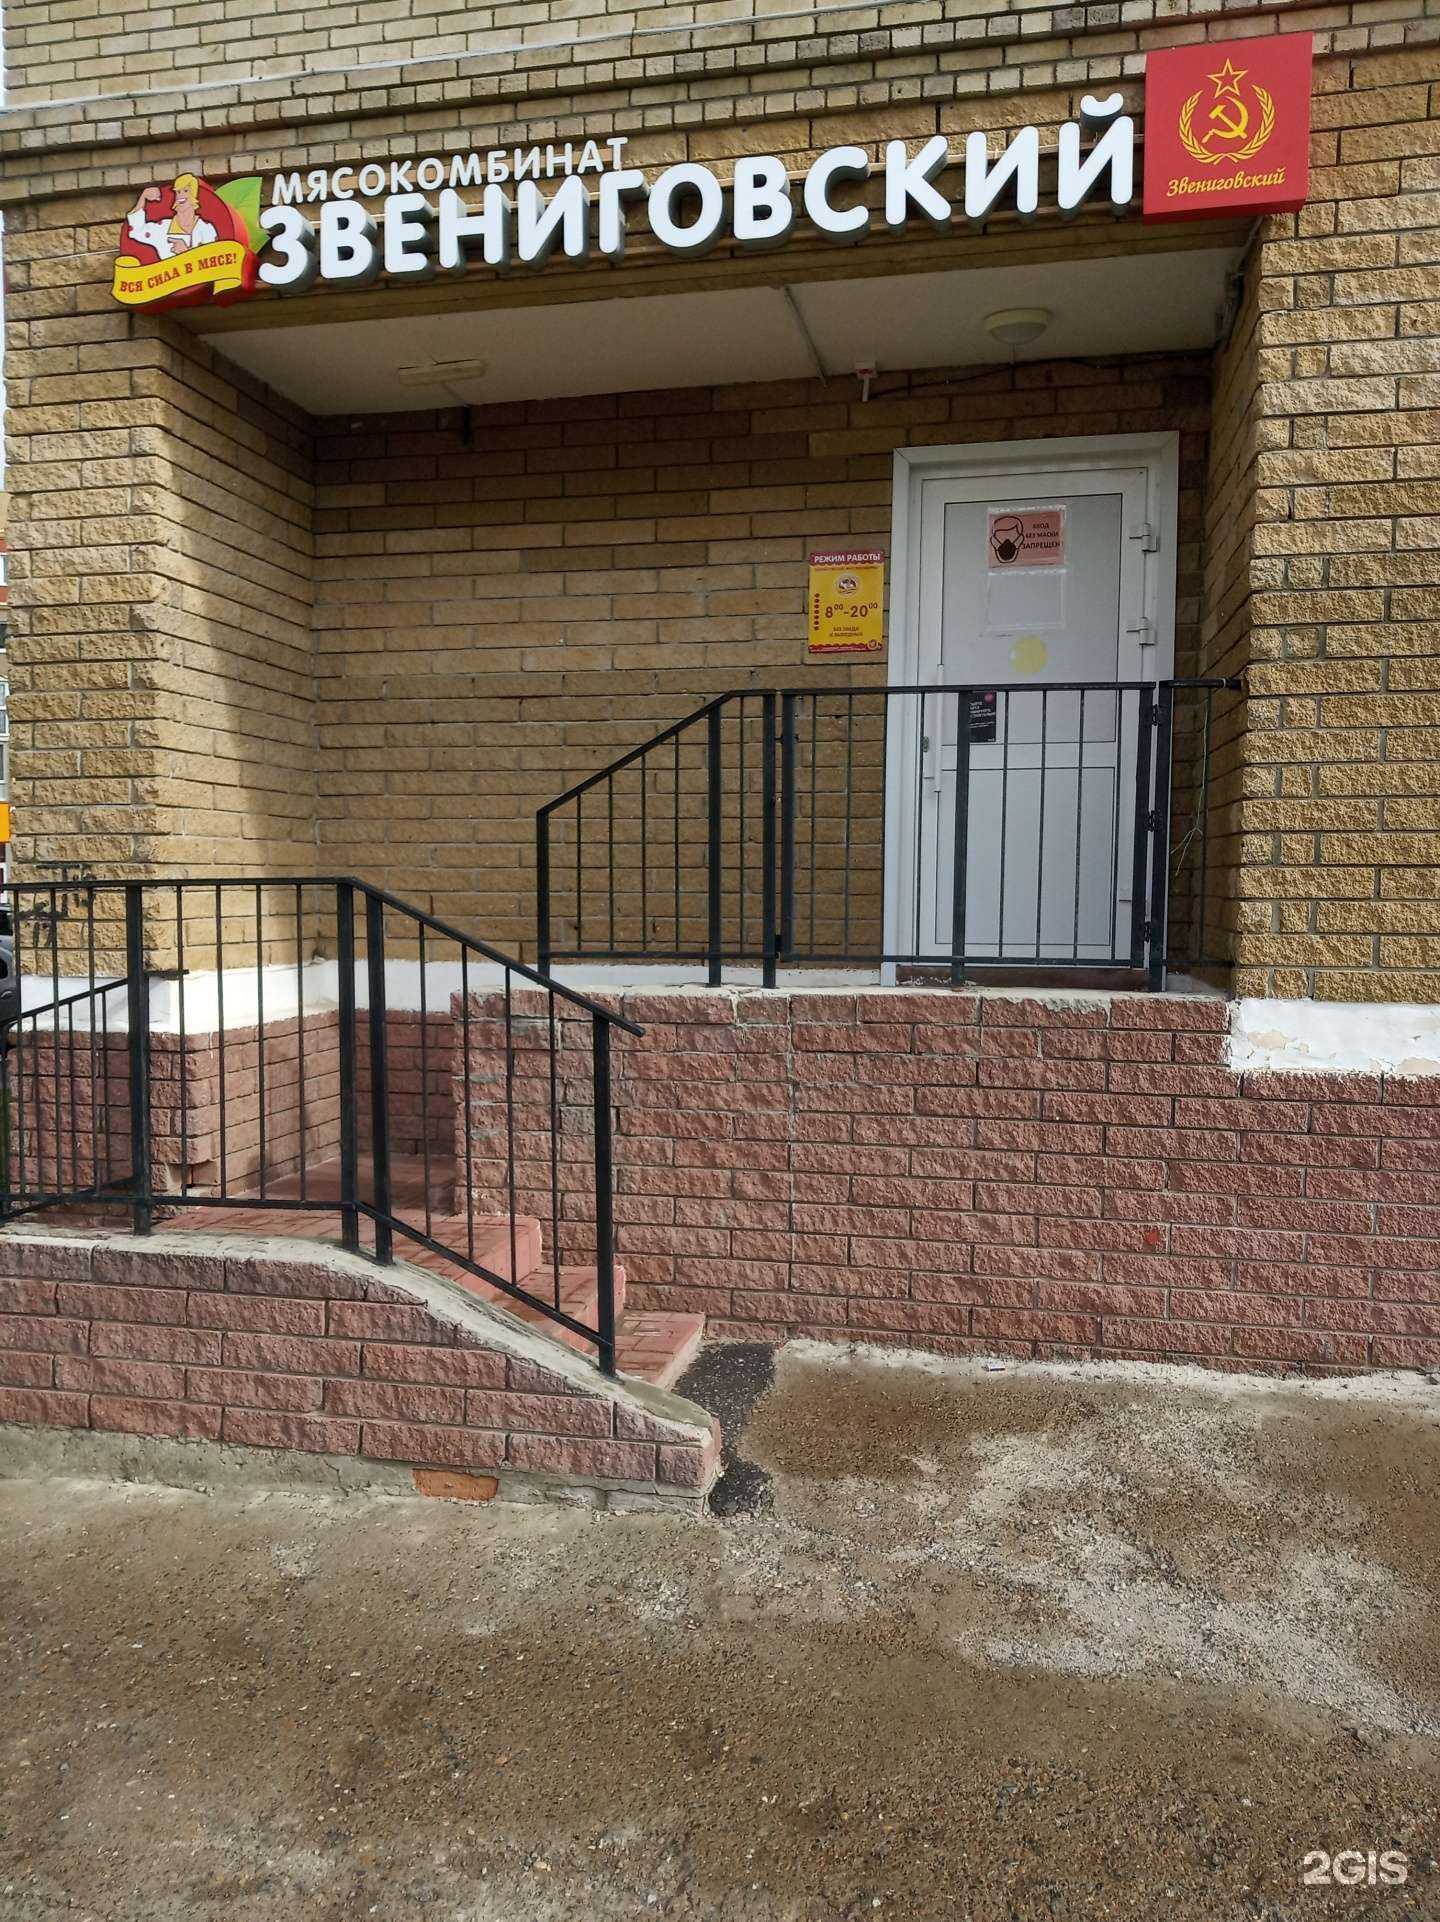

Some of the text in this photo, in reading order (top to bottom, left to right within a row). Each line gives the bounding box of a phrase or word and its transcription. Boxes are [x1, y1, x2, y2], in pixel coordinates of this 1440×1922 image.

[257, 92, 1136, 288] ЗВЕНИГОВСКИЙ
[272, 136, 629, 205] МЯСОКОМБИНАТ
[1166, 166, 1286, 197] Звениговский
[120, 252, 237, 293] ВСЯ СИЛА В МЯСЕ!
[814, 553, 881, 563] РЕЖИМ РАБОТЫ
